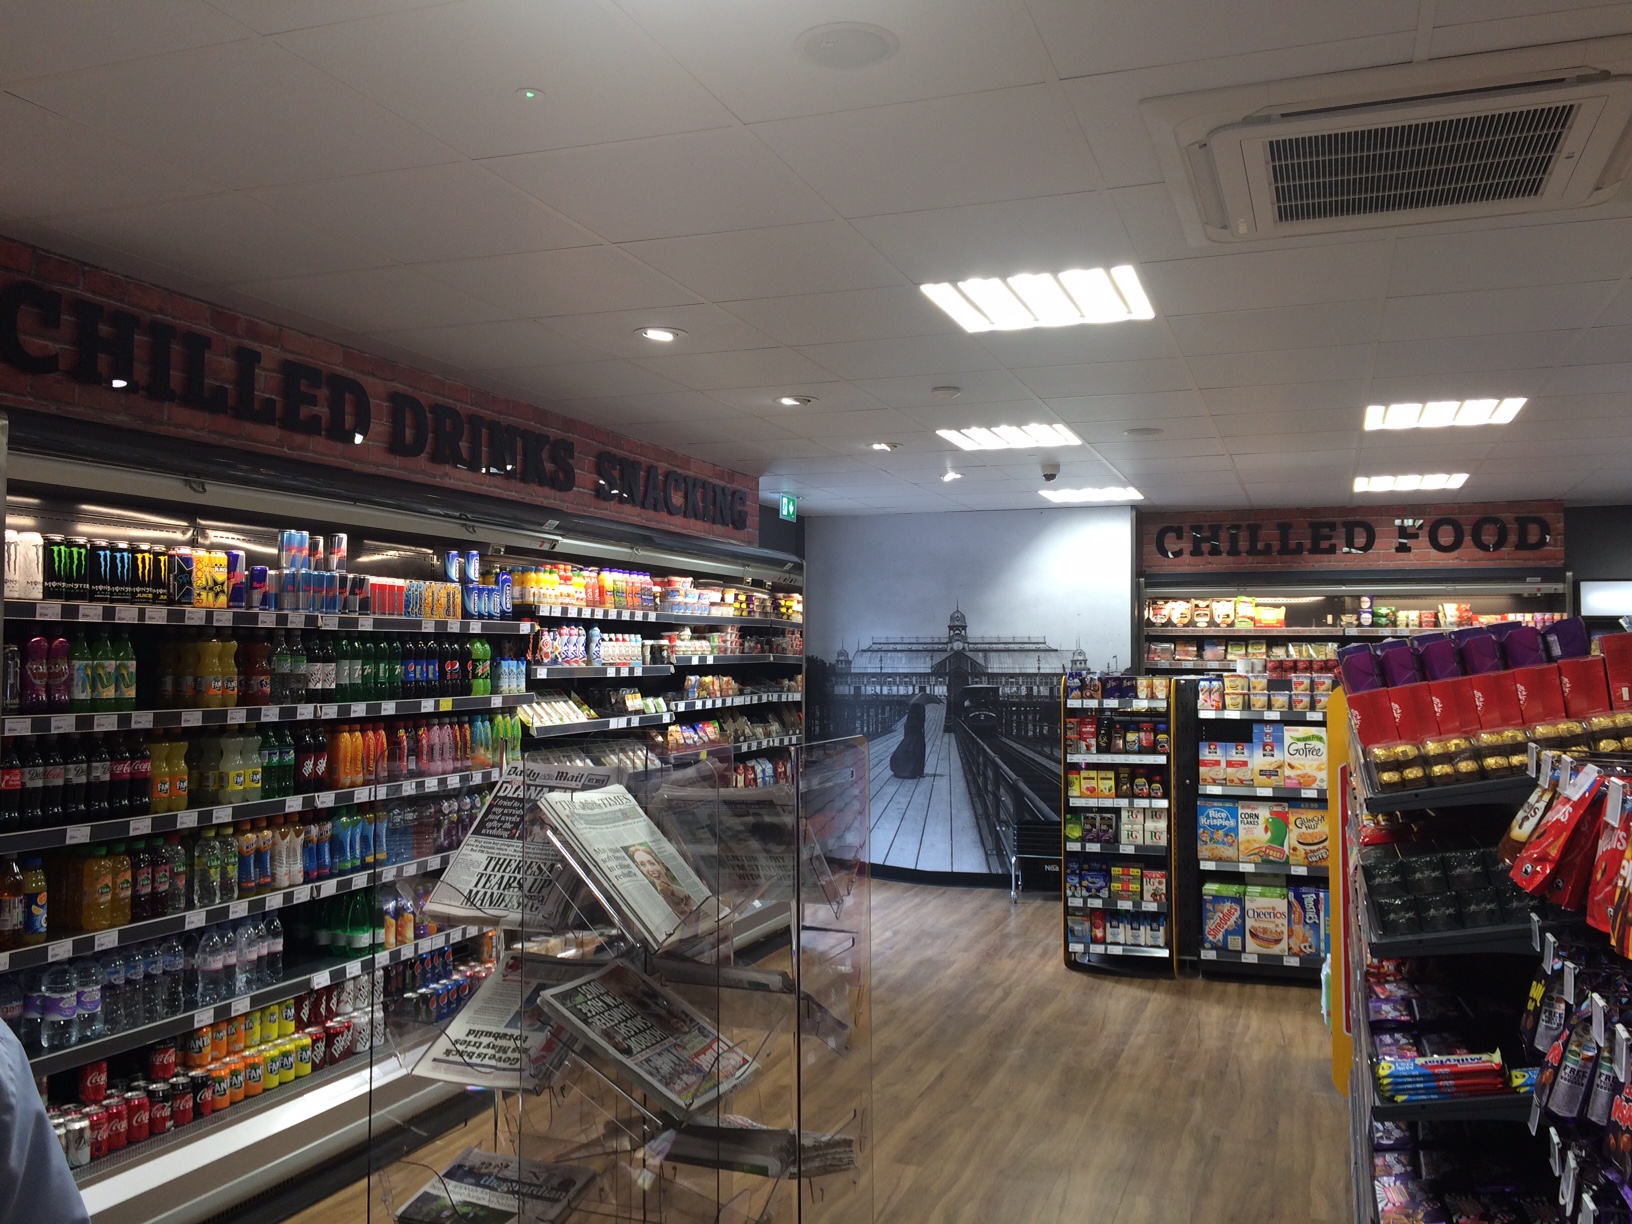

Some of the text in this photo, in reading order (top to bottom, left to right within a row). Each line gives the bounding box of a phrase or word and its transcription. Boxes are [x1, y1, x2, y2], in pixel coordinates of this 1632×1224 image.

[1, 281, 748, 530] CHILLED DRINKS SNACKING
[1155, 515, 1551, 559] CHILLED FOOD
[1287, 741, 1324, 758] GoFree
[554, 771, 585, 784] Mail
[600, 794, 632, 809] TIMES
[1209, 810, 1227, 819] Rice
[1240, 813, 1260, 821] CORN
[504, 822, 514, 830] the
[1200, 817, 1236, 827] Krispies
[481, 828, 511, 839] wedding
[482, 856, 556, 879] THERESA
[528, 877, 554, 894] UP
[1246, 907, 1287, 920] Cheerios
[1207, 905, 1239, 941] Shreddies
[1543, 1008, 1564, 1020] FREE
[1562, 1064, 1588, 1078] FREE
